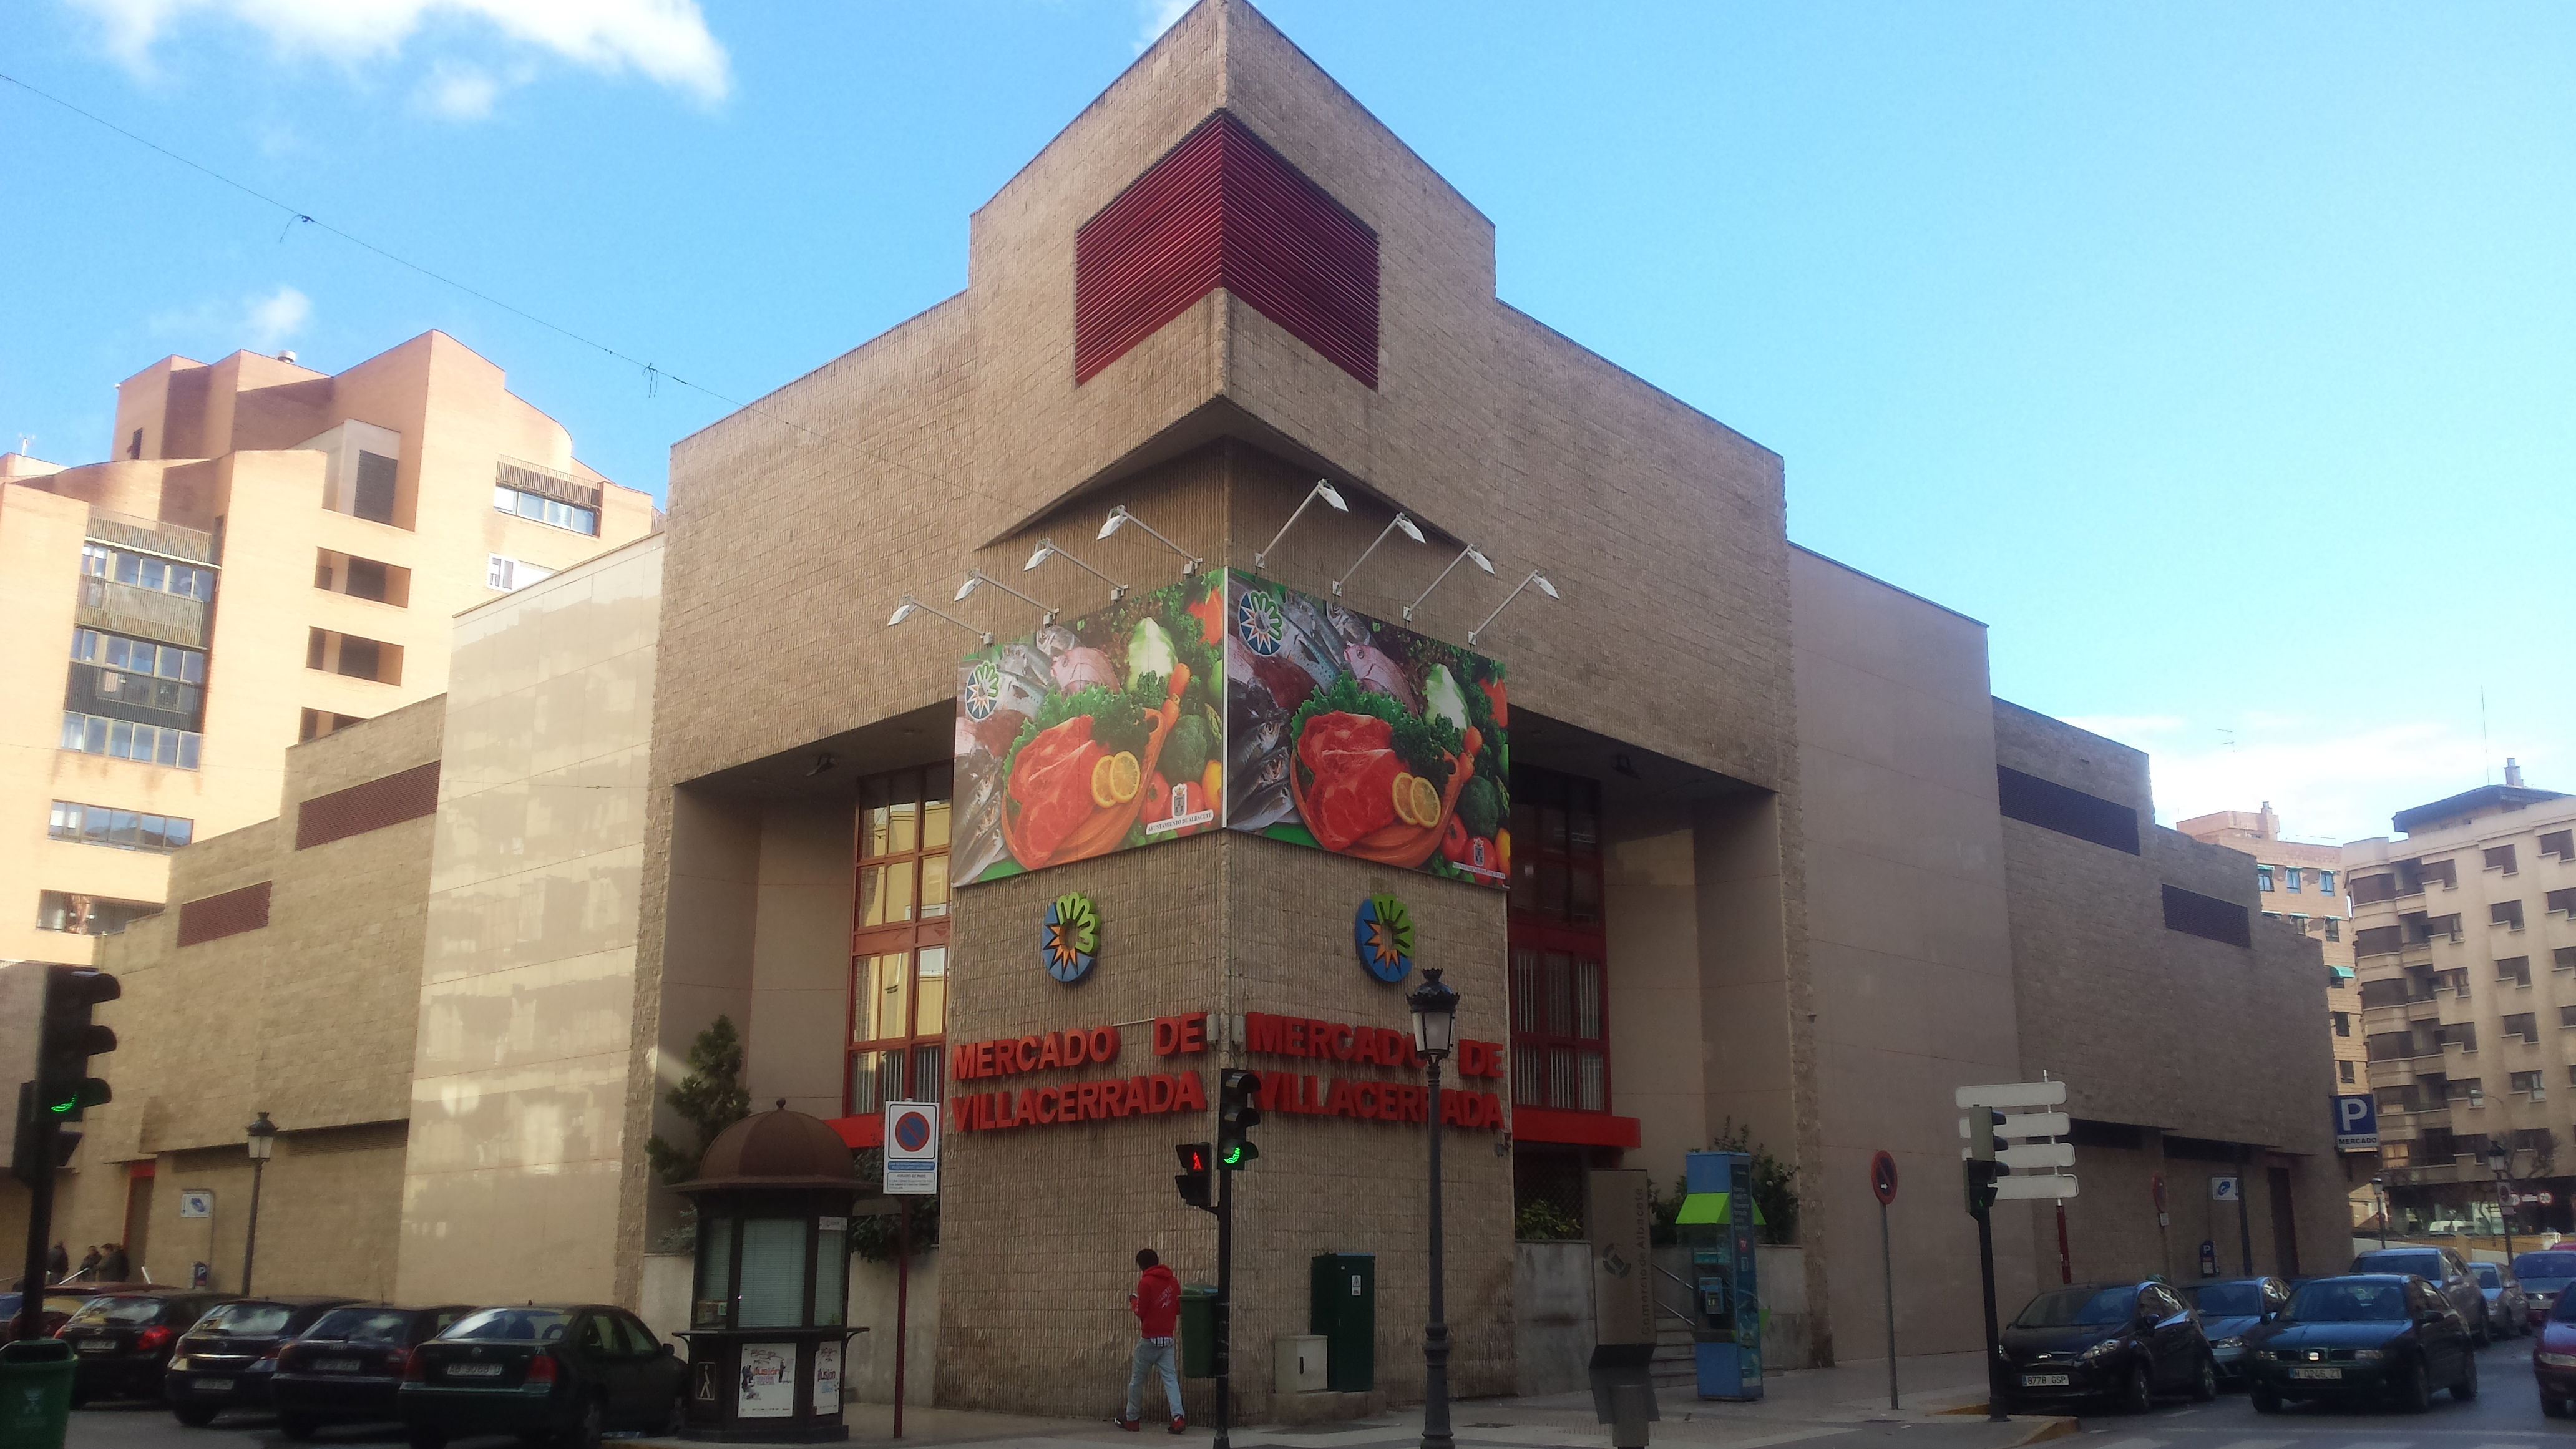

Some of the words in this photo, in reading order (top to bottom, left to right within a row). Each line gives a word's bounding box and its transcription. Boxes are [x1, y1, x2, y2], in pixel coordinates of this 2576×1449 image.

[1189, 812, 1211, 822] ALBACETE
[951, 1025, 1121, 1080] MERCADO
[1153, 1012, 1208, 1056] DE
[1458, 1039, 1505, 1078] DE
[951, 1070, 1207, 1133] VILLACERRADA
[2340, 1098, 2368, 1131] P
[2027, 1376, 2047, 1385] 8778
[2051, 1375, 2066, 1384] GSP
